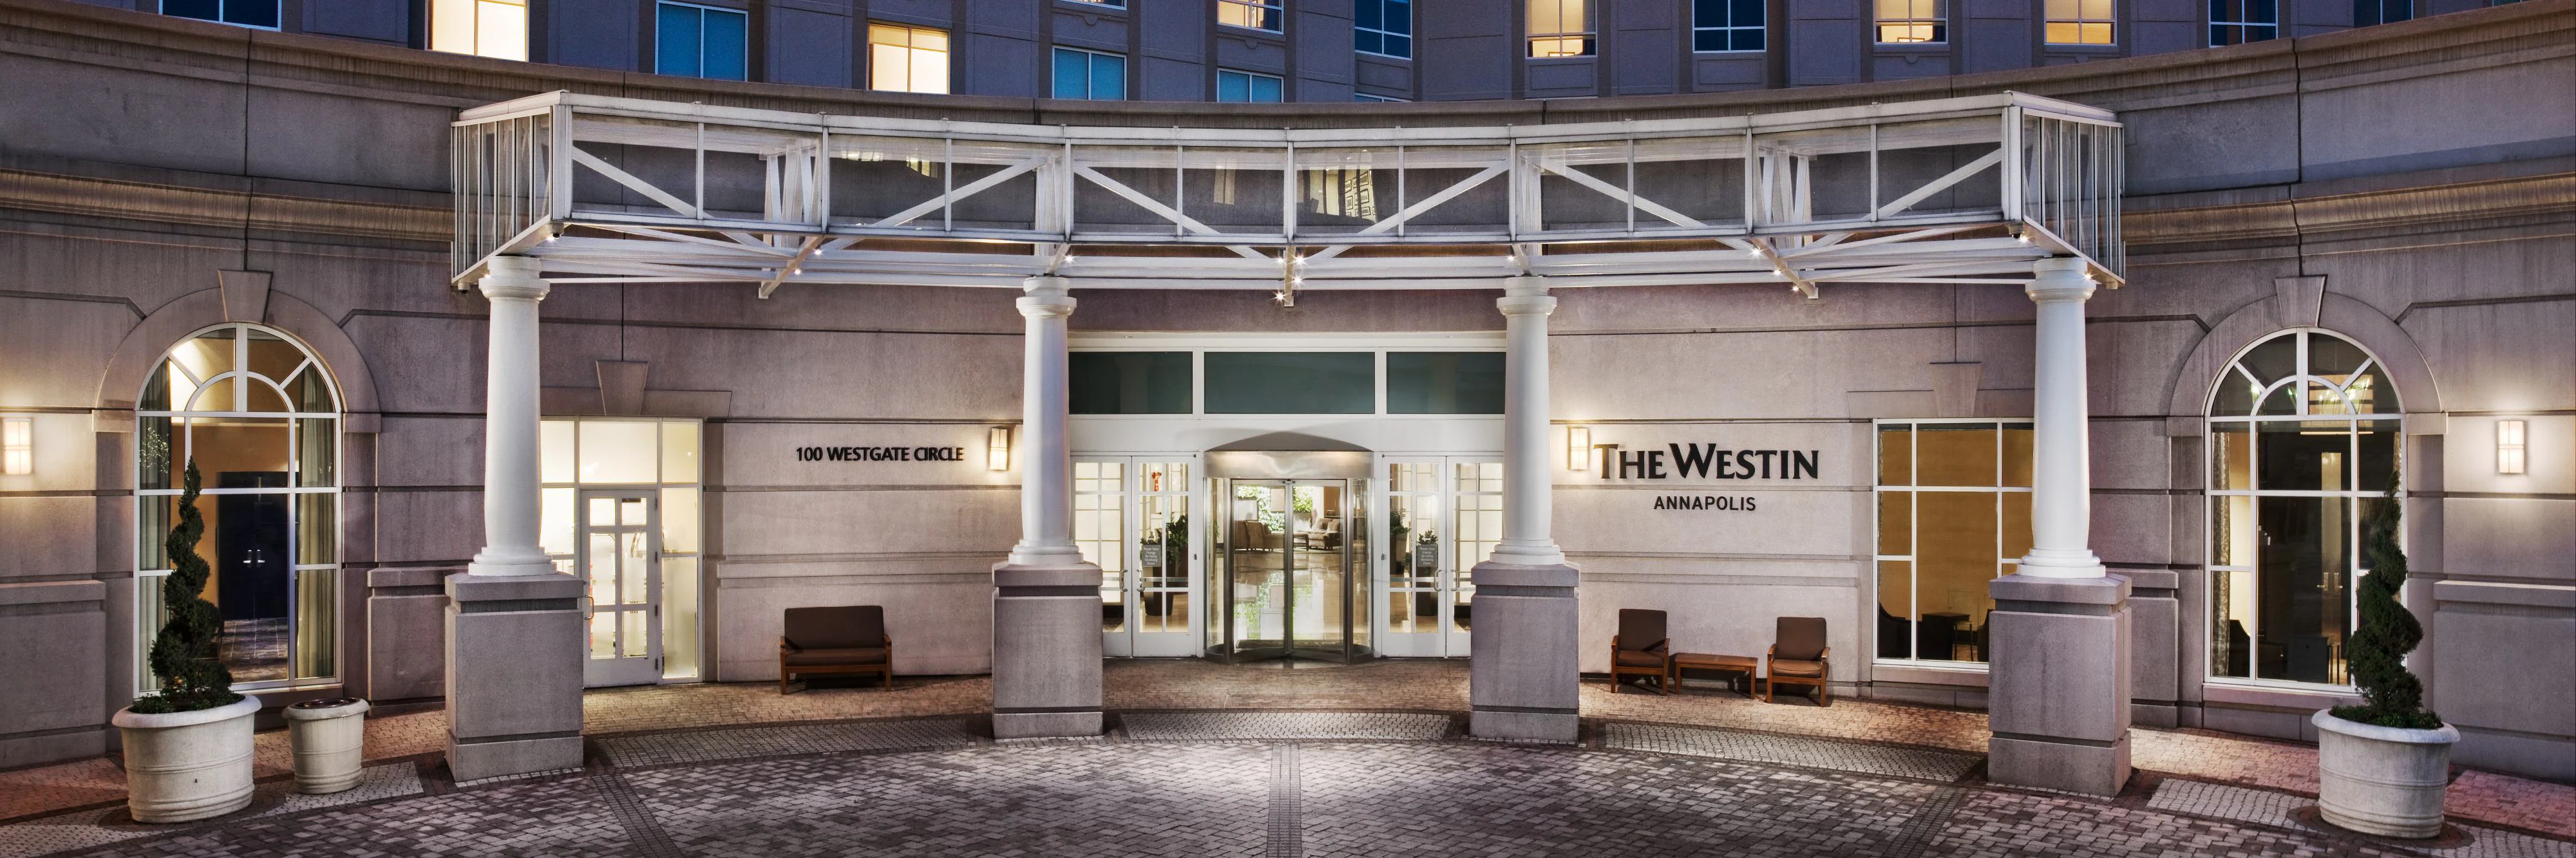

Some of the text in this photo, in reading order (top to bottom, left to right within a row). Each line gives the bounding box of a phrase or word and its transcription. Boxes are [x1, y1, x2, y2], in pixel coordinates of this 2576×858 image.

[796, 447, 963, 462] 100 WESTGATE CIRCLE
[1593, 443, 1819, 480] THE WESTIN
[1653, 496, 1756, 511] ANNAPOLIS
